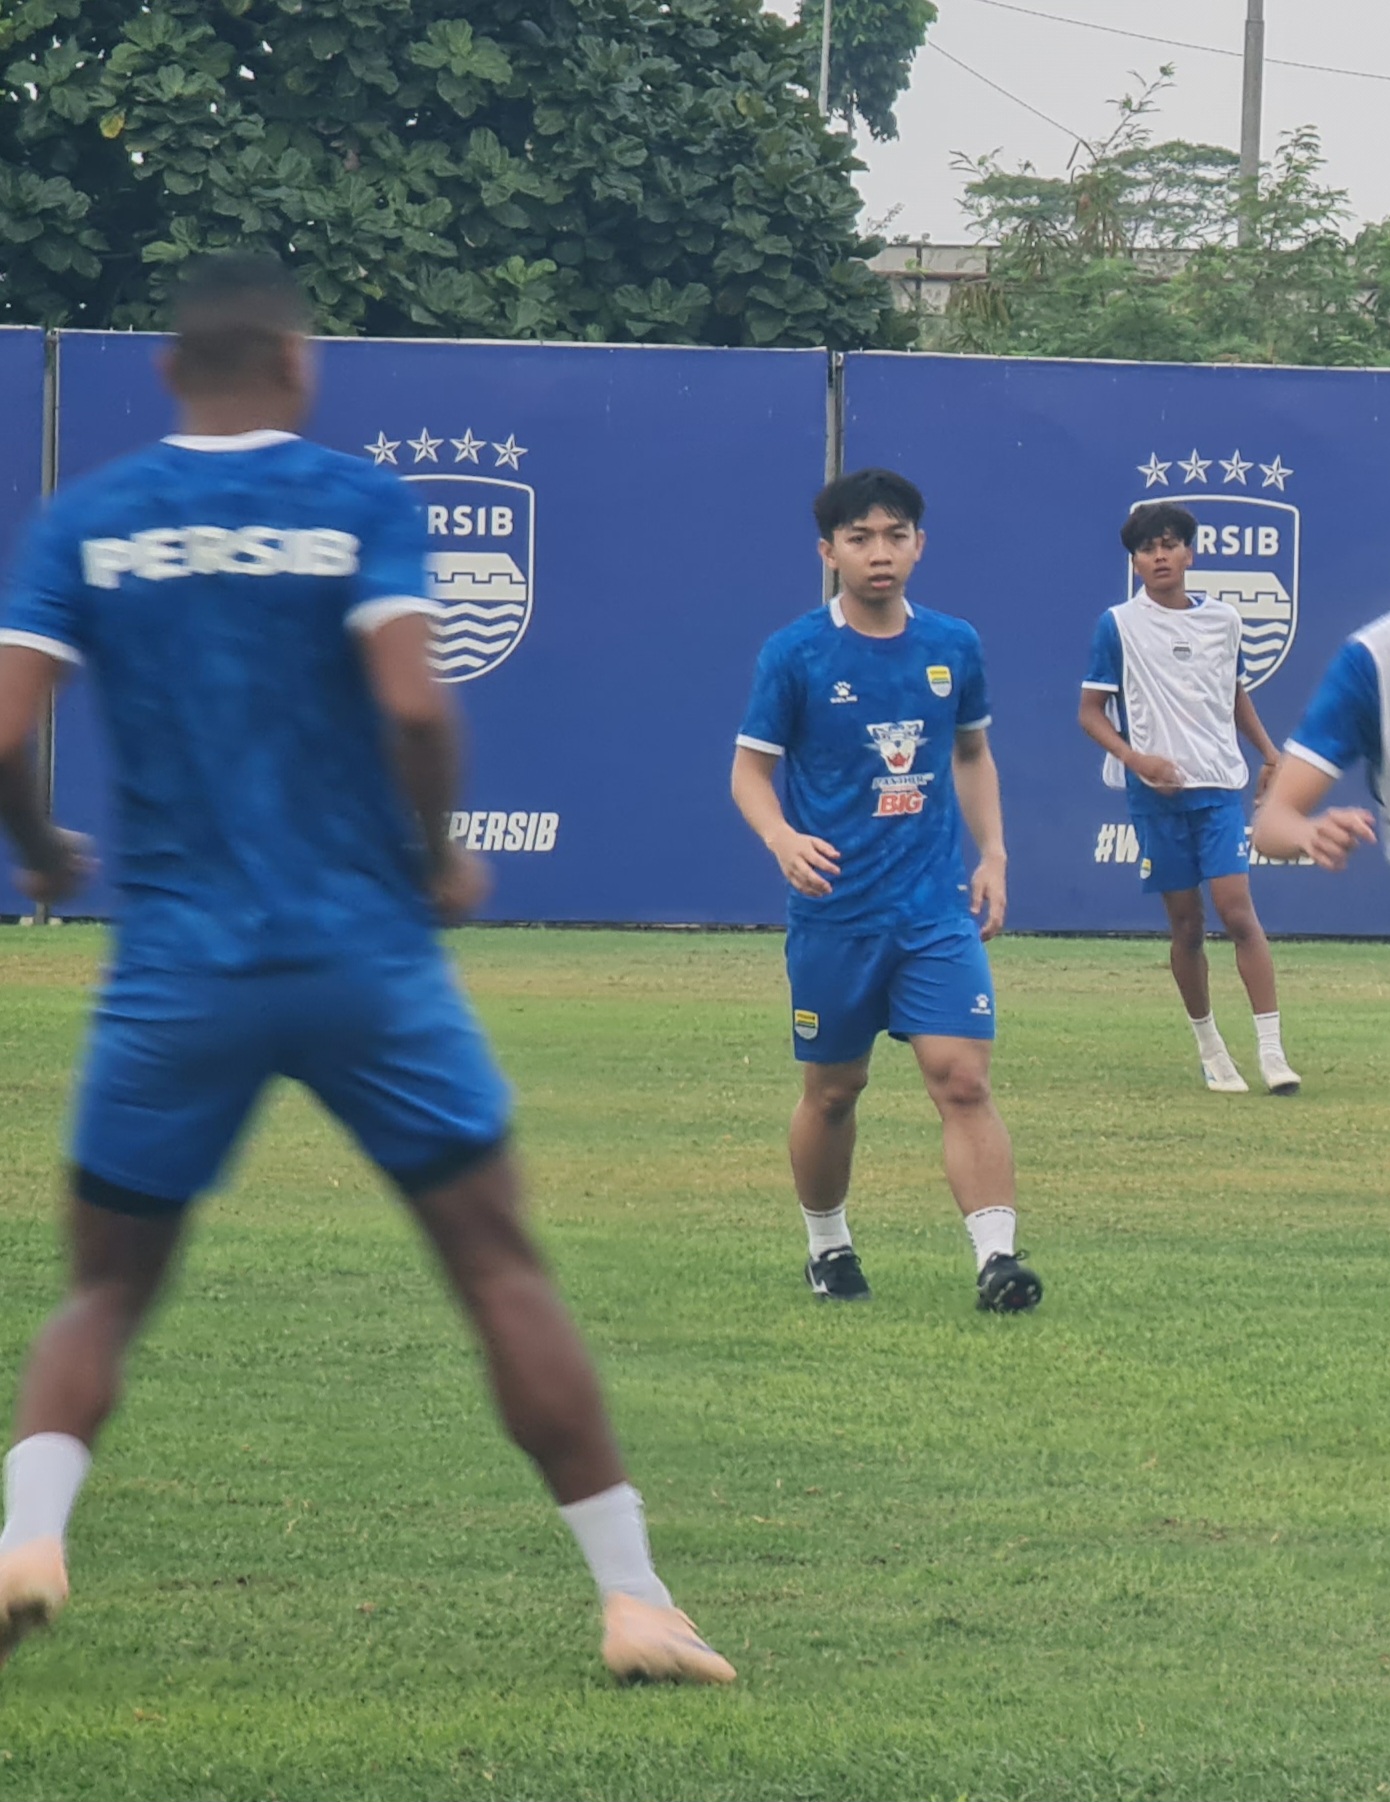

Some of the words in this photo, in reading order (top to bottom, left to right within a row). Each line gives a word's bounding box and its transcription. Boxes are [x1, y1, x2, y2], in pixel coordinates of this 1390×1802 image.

[428, 505, 515, 537] RSIB
[81, 525, 361, 589] PERSIB
[1195, 524, 1281, 557] RSIB
[878, 792, 925, 816] BIG
[449, 811, 560, 852] PERSIB
